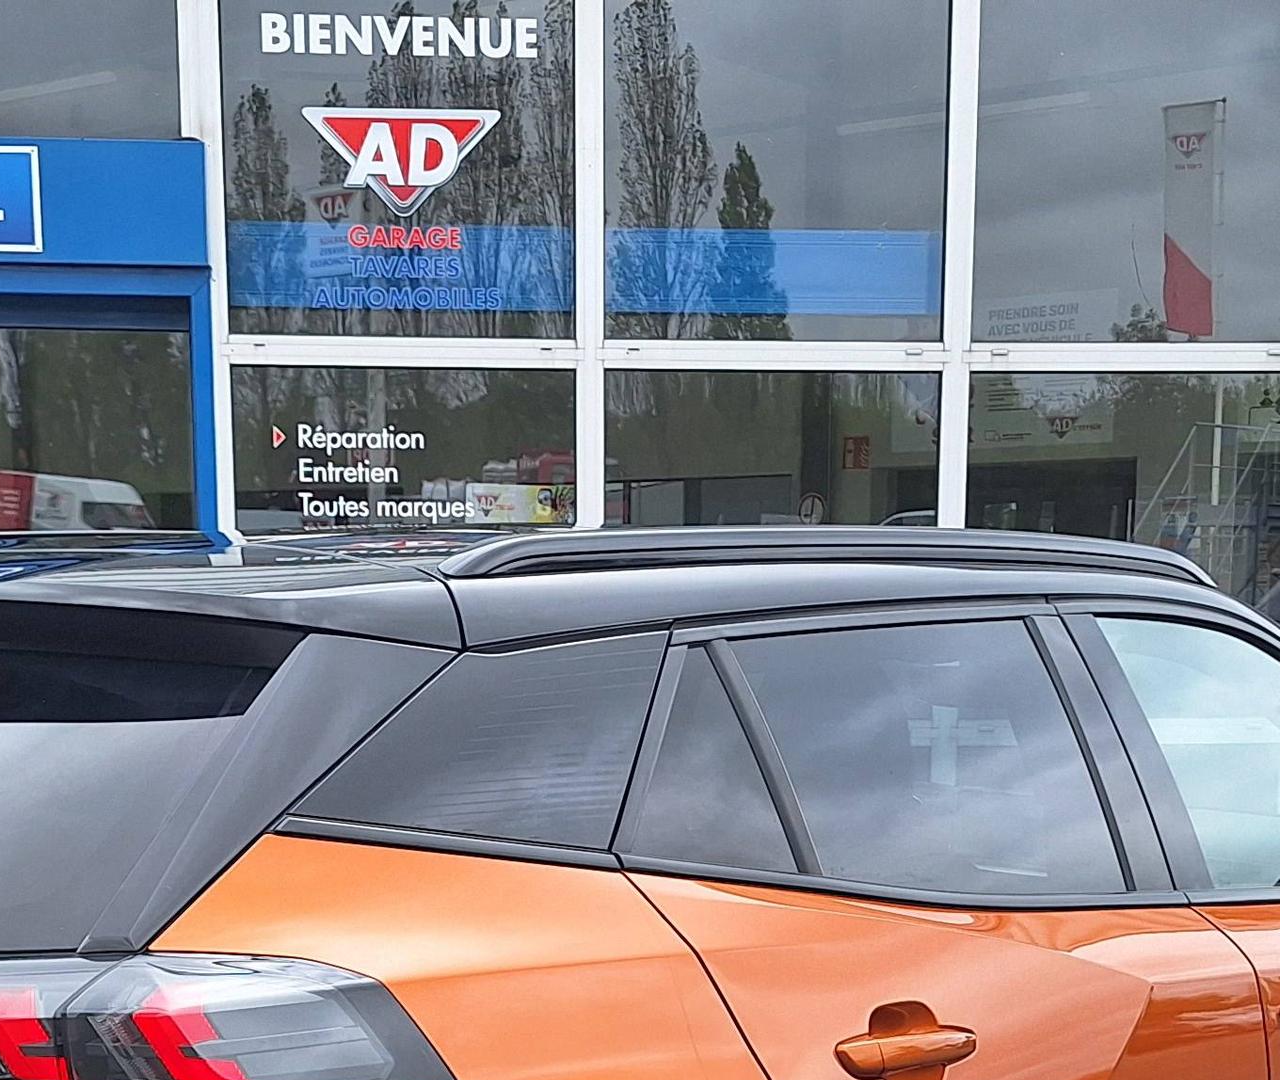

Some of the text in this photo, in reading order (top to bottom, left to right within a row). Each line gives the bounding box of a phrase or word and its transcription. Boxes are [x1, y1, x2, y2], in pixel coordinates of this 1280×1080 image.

[260, 12, 538, 58] BIENVENUE
[344, 122, 460, 188] AD
[347, 224, 462, 250] GARAGE
[349, 254, 461, 280] TAVARES
[312, 286, 502, 310] AUTOMOBILES
[988, 302, 1079, 322] PRENDRE SOIN
[988, 318, 1076, 336] AVEC VOUS DE
[1053, 418, 1073, 432] AD
[297, 424, 425, 456] Réparation
[298, 458, 399, 483] Entretien
[297, 492, 476, 525] Toutes marques
[480, 496, 495, 509] AD
